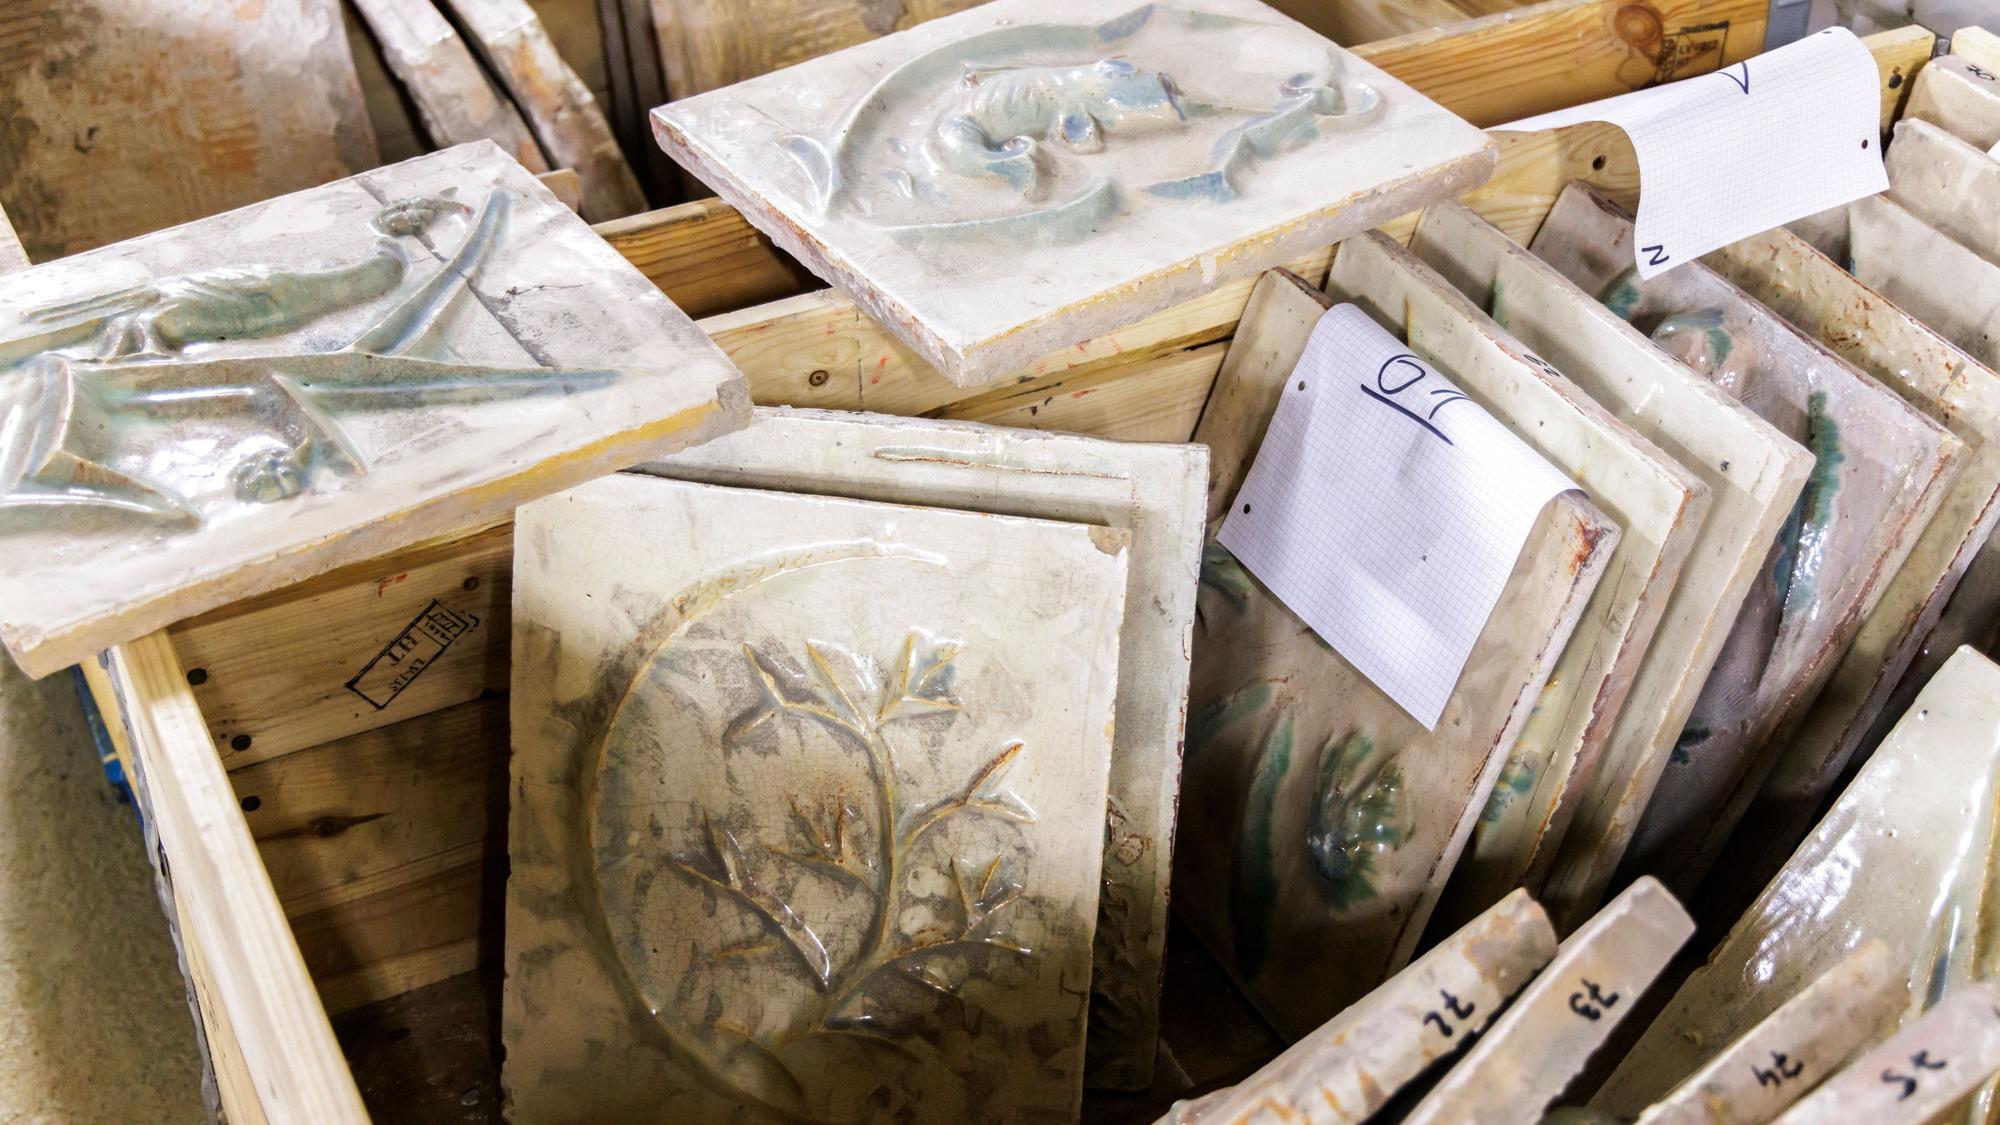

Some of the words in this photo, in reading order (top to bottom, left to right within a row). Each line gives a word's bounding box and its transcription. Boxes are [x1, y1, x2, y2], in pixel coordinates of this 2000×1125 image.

[1423, 988, 1475, 1038] 72
[1568, 977, 1620, 1021] 73
[1751, 1049, 1804, 1088] 74
